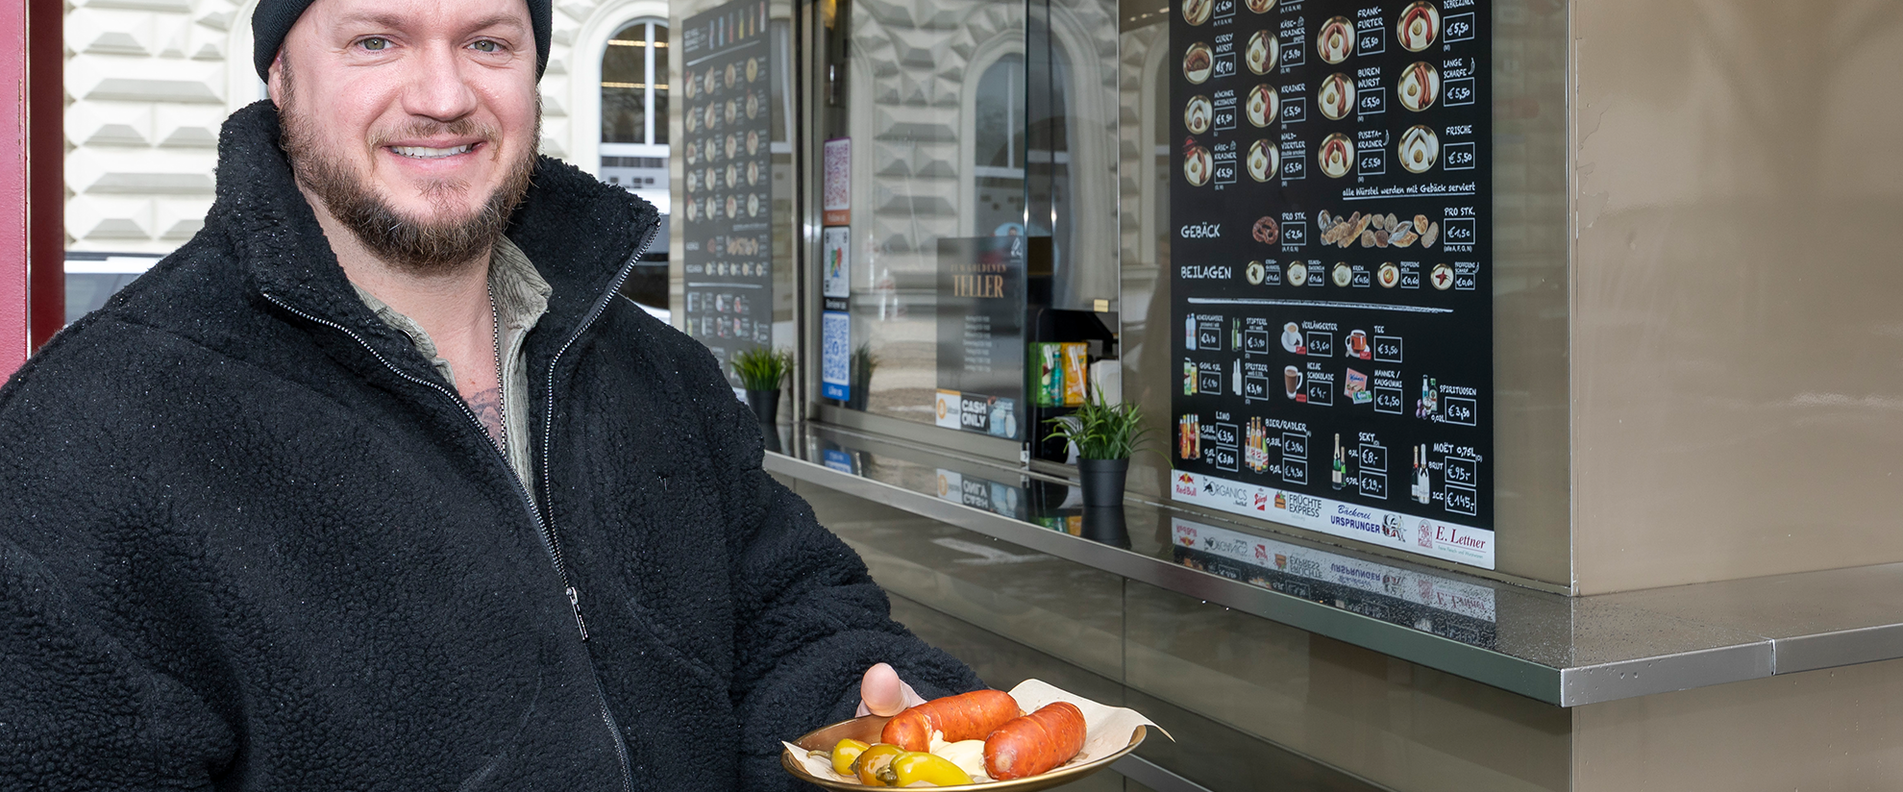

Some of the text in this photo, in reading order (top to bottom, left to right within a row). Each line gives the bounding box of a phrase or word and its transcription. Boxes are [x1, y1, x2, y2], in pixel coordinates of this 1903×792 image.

[1357, 5, 1382, 19] FRANK-
[1357, 17, 1384, 29] FURTER
[1446, 22, 1469, 36] €5,50
[1215, 32, 1234, 44] CURRY
[1280, 27, 1305, 38] KRAINER
[1361, 36, 1379, 49] €5,50
[1443, 58, 1463, 69] LANGE
[1281, 83, 1306, 94] KRAINER
[1358, 77, 1380, 89] WURST
[1447, 87, 1470, 100] €5,50
[1361, 96, 1380, 109] €5,50
[1358, 130, 1382, 140] PUSZTA-
[1445, 124, 1473, 136] FRISCHE
[1358, 139, 1383, 149] KRAINER
[1214, 151, 1237, 160] KRAINER
[1284, 162, 1302, 174] €5,50
[1361, 157, 1381, 169] €5,50
[1342, 181, 1476, 196] alle Würstel werden mit Gebäck serviert
[1281, 211, 1306, 220] PRO STK.
[1444, 206, 1475, 216] PRO STK.
[1180, 221, 1221, 239] GEBÄCK
[1447, 226, 1470, 238] €1,50
[1180, 265, 1232, 279] BEILAGEN
[953, 274, 1004, 299] TELLER
[1301, 320, 1338, 332] VERLÄNGERTER
[1374, 325, 1385, 334] TEE
[1310, 340, 1330, 352] €3,60
[1377, 343, 1399, 356] €3,50
[1306, 371, 1334, 382] SCHOKOLADE
[1374, 369, 1396, 379] MANNER
[1374, 379, 1403, 388] KAUGUMMI
[1439, 384, 1477, 396] SPIRITUOSEN
[1377, 394, 1400, 407] €2,50
[961, 399, 987, 415] CASH
[961, 412, 986, 428] ONLY
[1215, 411, 1230, 421] LIMO
[1265, 418, 1307, 433] BIER/RADLER
[1358, 431, 1375, 442] SEKT
[1433, 442, 1454, 454] MOËT
[1428, 461, 1444, 470] BRUT
[1176, 484, 1197, 497] Red Bull
[1432, 491, 1444, 501] ICE
[1289, 493, 1322, 509] FRÜCHTE
[1289, 503, 1320, 518] EXPRESS
[1337, 504, 1372, 520] Bäckerei
[1330, 515, 1381, 535] URSPRUNGER
[1435, 525, 1487, 550] E. Lettner
